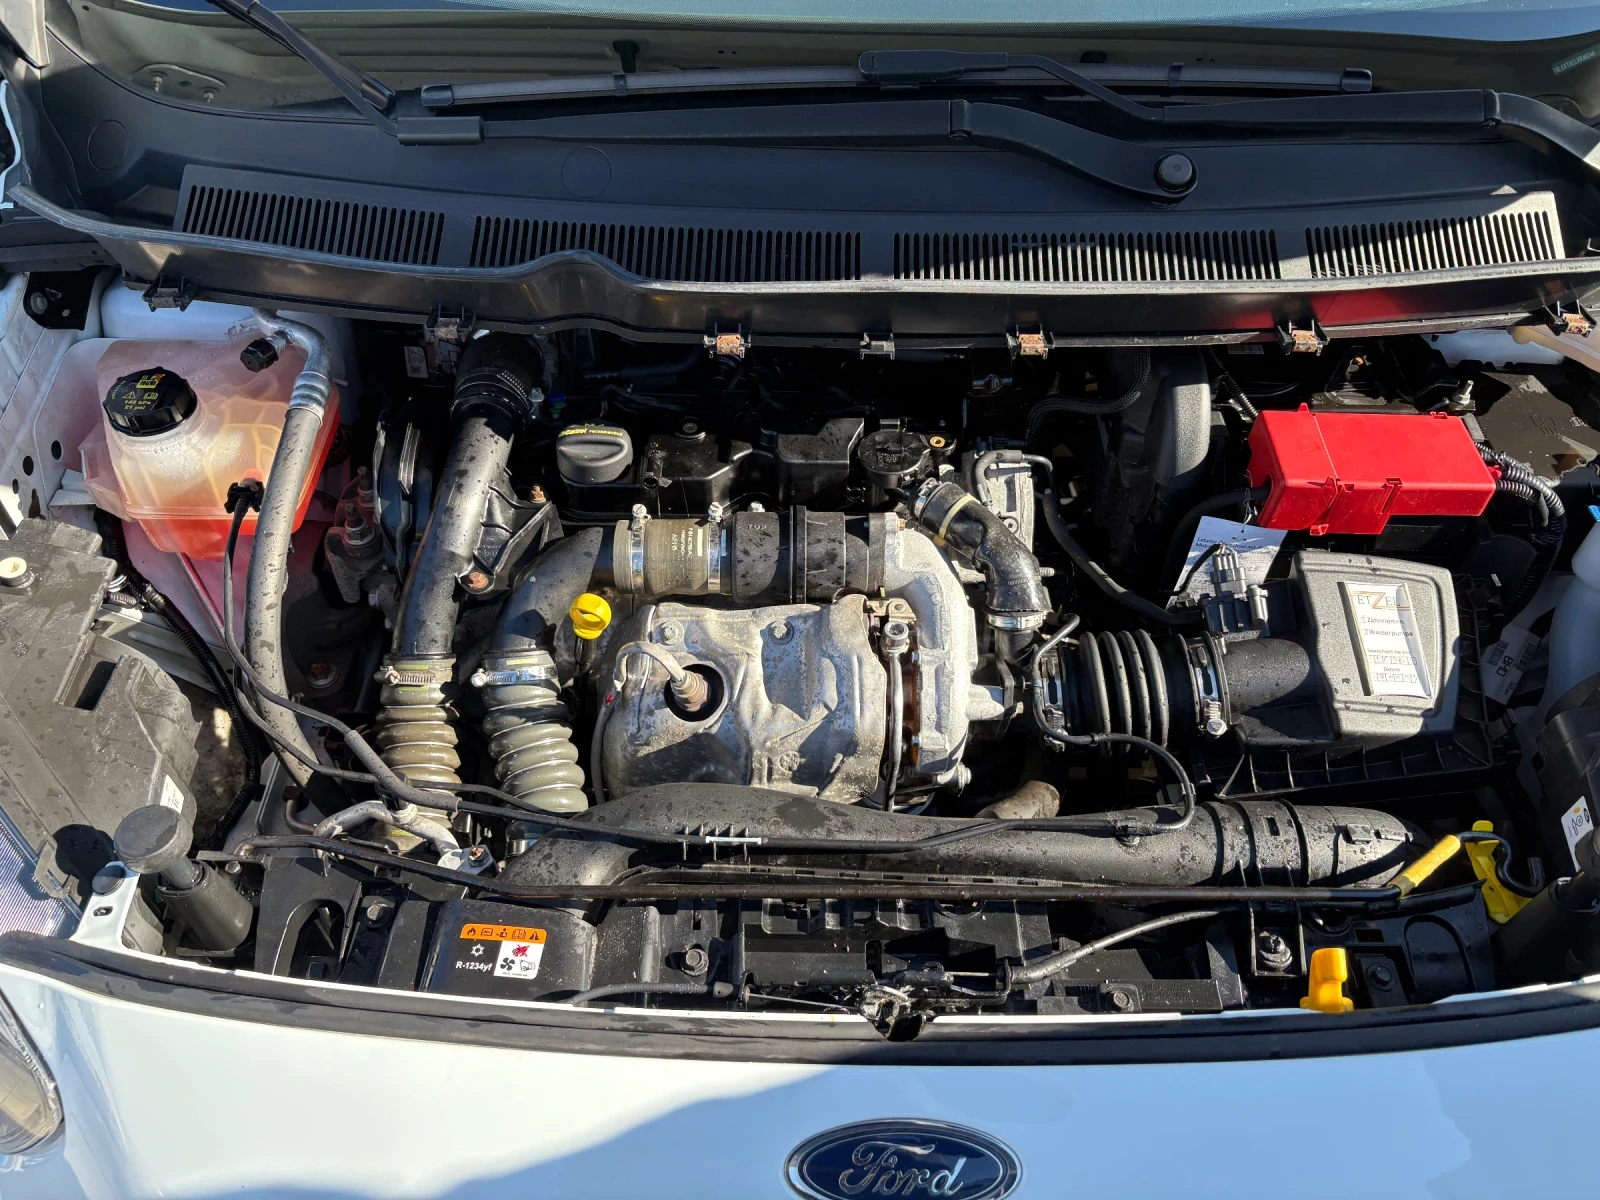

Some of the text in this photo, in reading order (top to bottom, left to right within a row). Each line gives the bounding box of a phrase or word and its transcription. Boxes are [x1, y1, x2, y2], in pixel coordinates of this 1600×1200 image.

[1367, 617, 1405, 625] Zahnriemen
[1369, 628, 1414, 638] Wasserpumpe
[455, 961, 493, 972] R-1234yf
[838, 1141, 967, 1197] Ford
